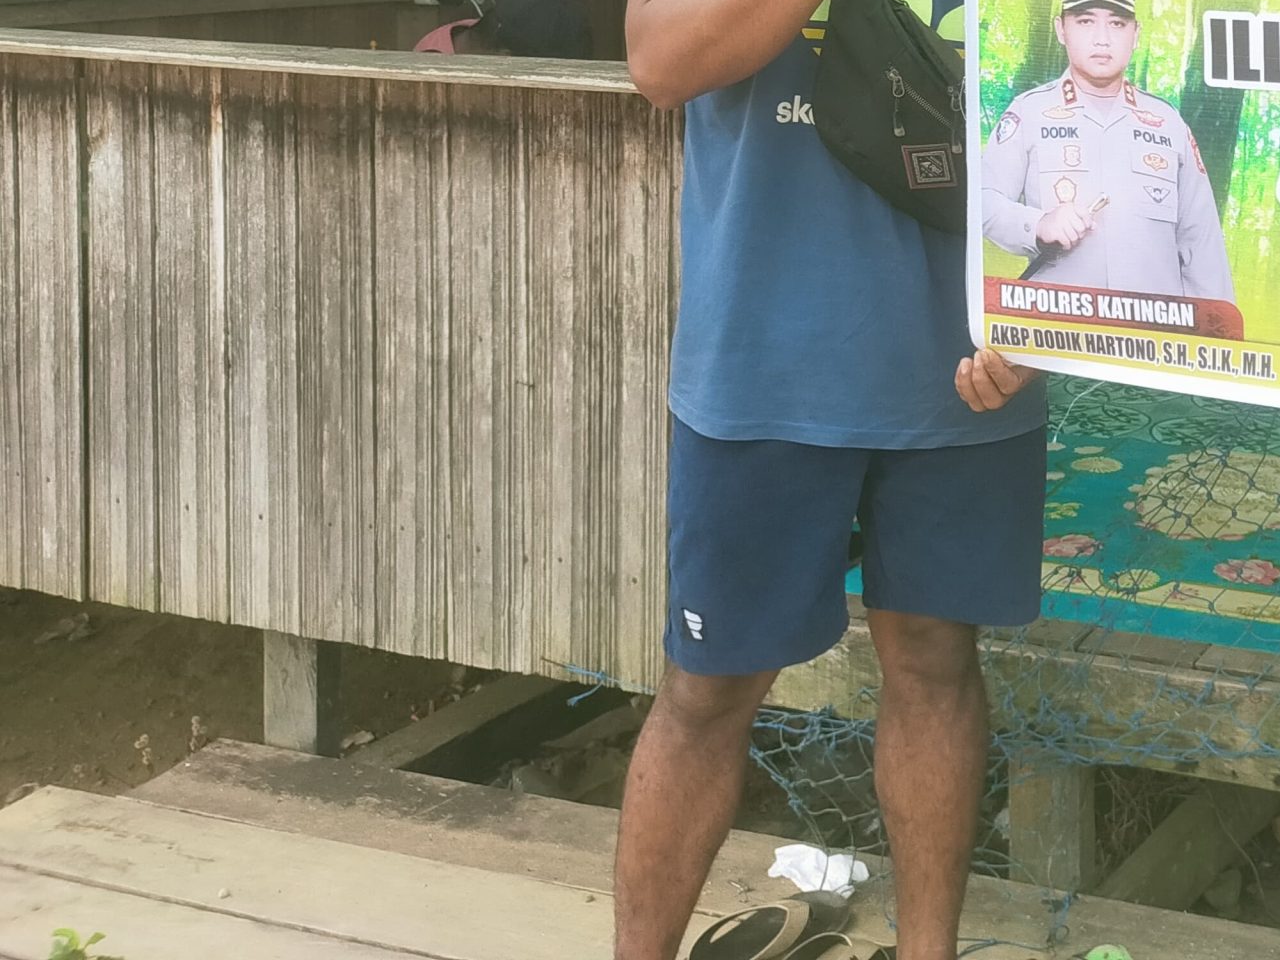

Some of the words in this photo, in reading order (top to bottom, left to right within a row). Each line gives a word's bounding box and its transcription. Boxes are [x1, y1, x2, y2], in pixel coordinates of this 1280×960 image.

[1040, 126, 1079, 140] DODIK
[1133, 129, 1173, 148] POLRI
[1000, 285, 1093, 318] KAPOLRES
[1098, 298, 1195, 328] KATINGAN
[990, 324, 1029, 347] AKBP
[1034, 329, 1083, 353] DODIK
[1085, 334, 1160, 365] HARTONO,
[1163, 344, 1194, 371] S.H.,
[1242, 353, 1276, 380] M.H.
